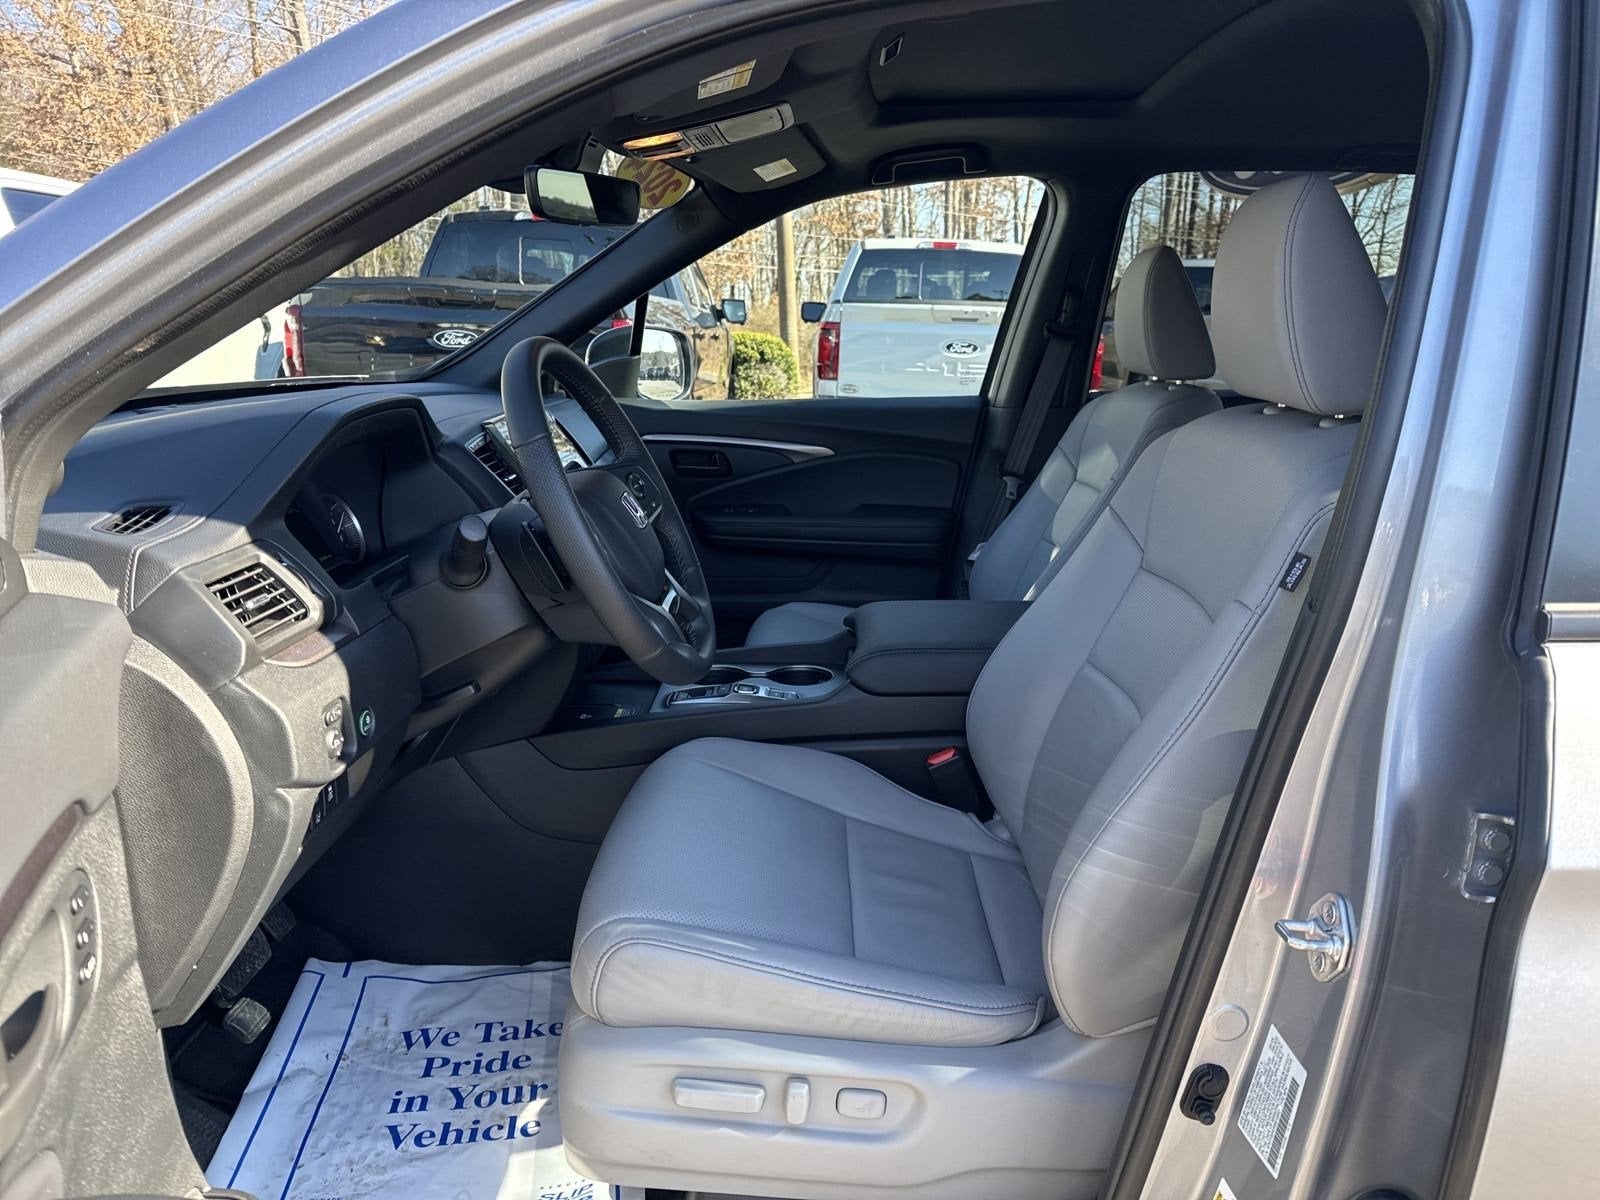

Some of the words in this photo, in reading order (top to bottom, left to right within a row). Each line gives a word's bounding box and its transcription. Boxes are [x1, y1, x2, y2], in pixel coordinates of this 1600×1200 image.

[440, 332, 475, 345] Ford
[400, 1027, 461, 1051] We
[474, 1019, 564, 1044] Take
[418, 1050, 533, 1079] Pride
[386, 1090, 429, 1115] in
[447, 1082, 549, 1111] Your
[384, 1115, 542, 1150] Vehicle
